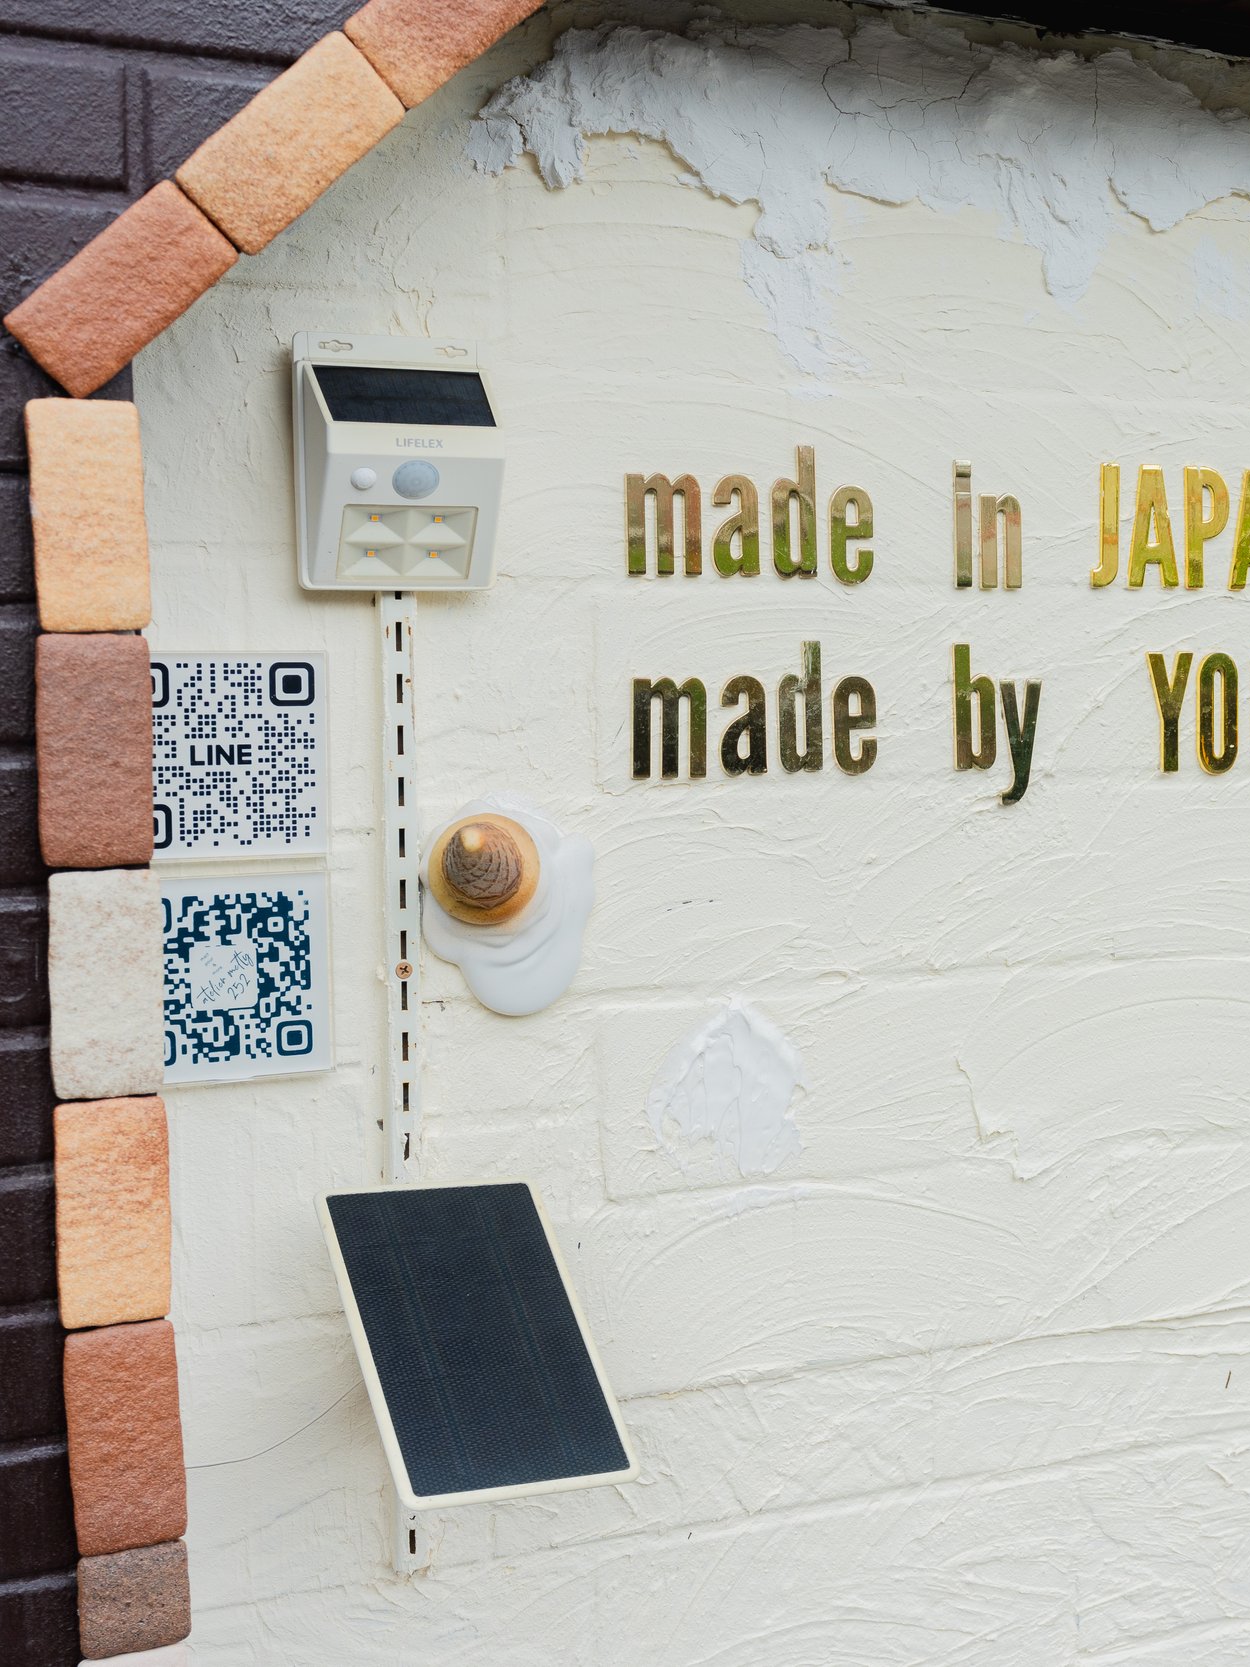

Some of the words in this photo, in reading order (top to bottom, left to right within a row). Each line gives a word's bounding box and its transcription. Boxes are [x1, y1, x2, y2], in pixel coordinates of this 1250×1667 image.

[396, 438, 444, 449] LIFELEX
[624, 445, 874, 586] made
[952, 459, 1023, 590] in
[631, 640, 878, 780] made
[951, 643, 1043, 805] by
[189, 744, 253, 766] LINE
[227, 974, 250, 1000] 252
